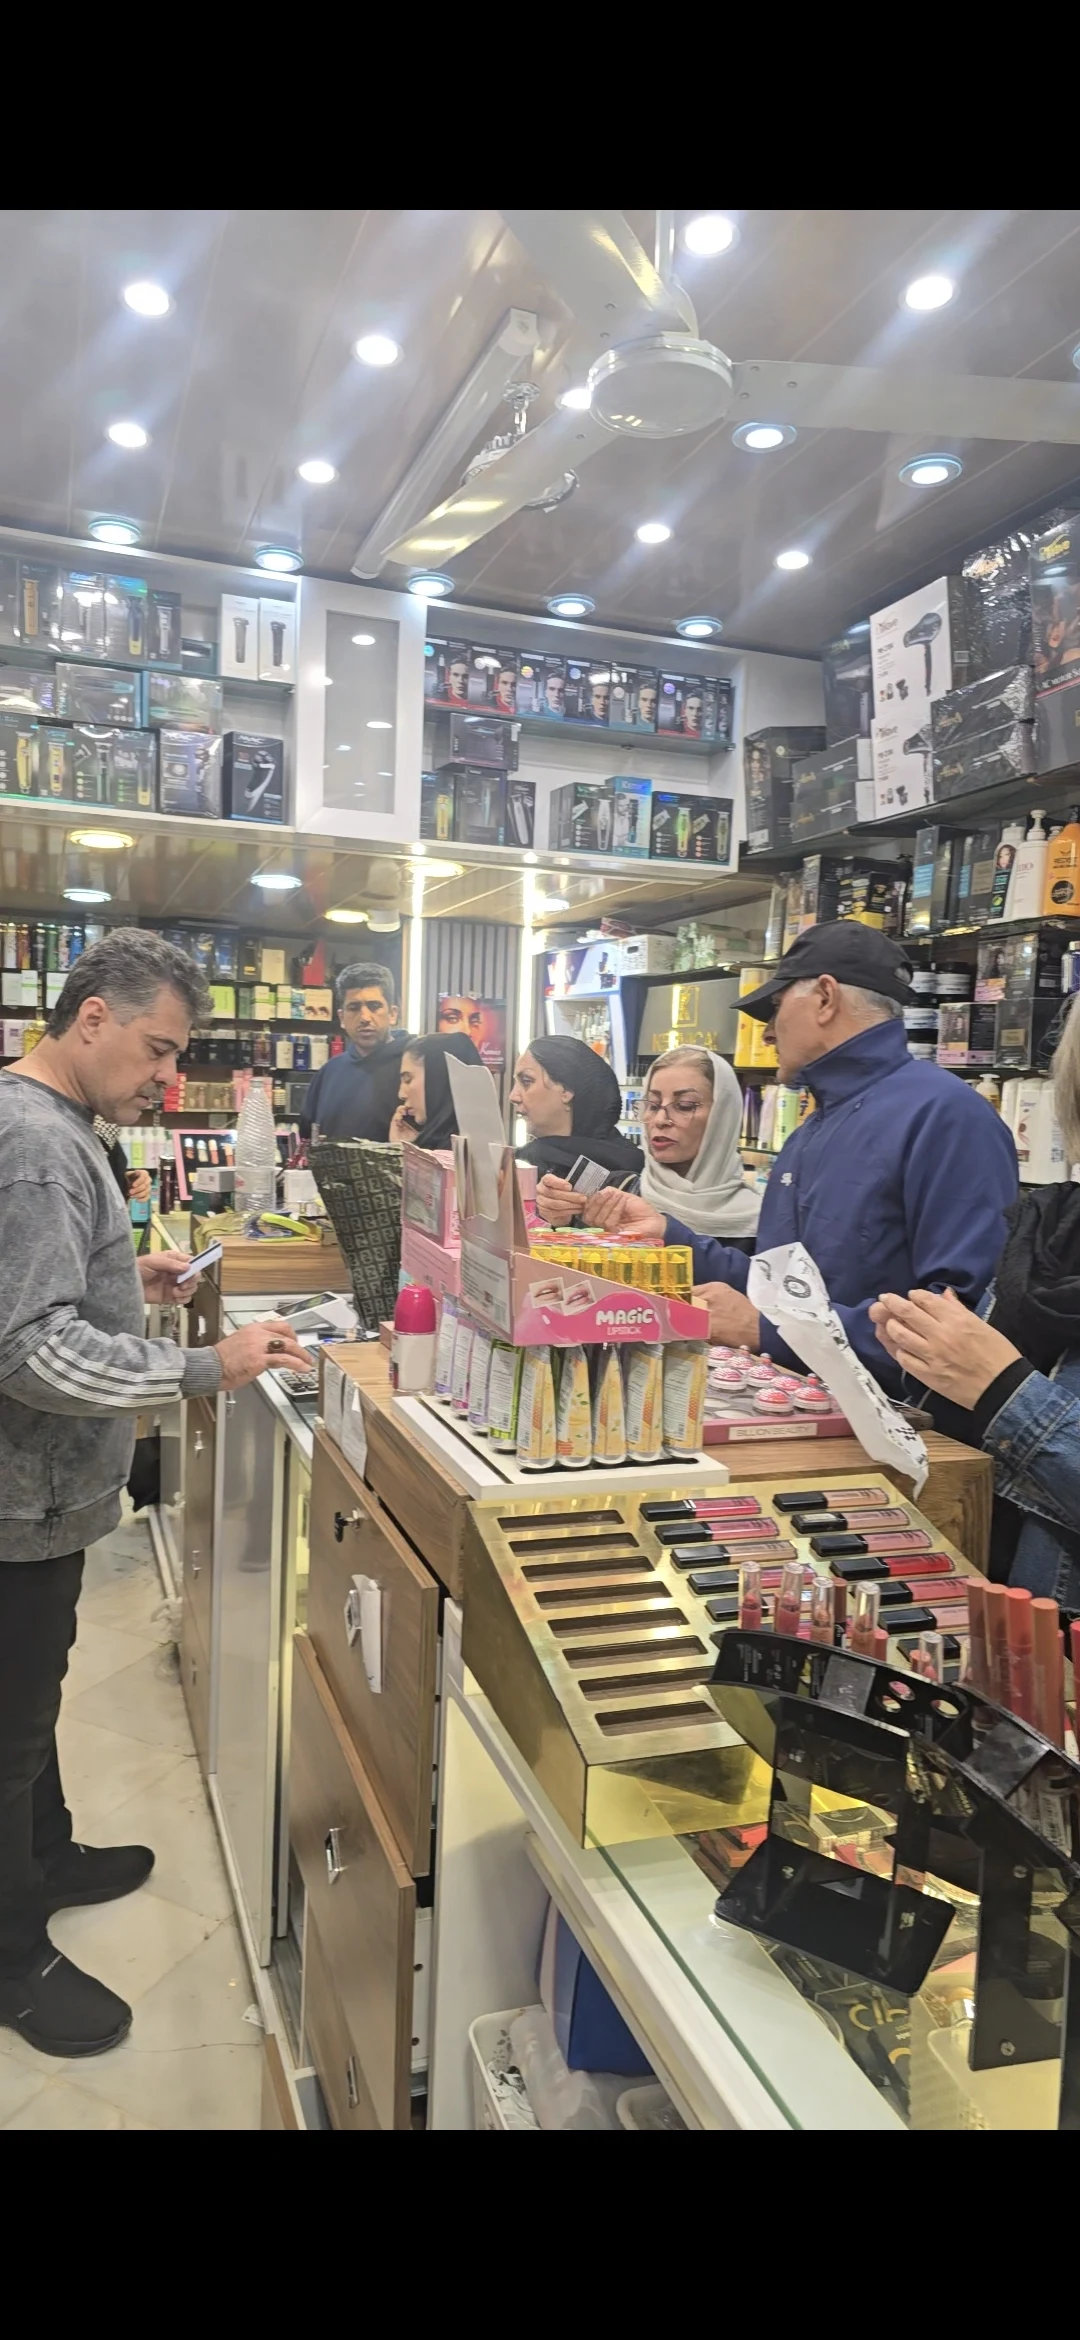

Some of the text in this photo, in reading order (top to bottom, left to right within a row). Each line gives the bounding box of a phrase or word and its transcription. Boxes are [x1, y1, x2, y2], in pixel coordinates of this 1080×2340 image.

[607, 1326, 642, 1336] LIPSTICK
[736, 1425, 810, 1437] BILLION BEAUTY
